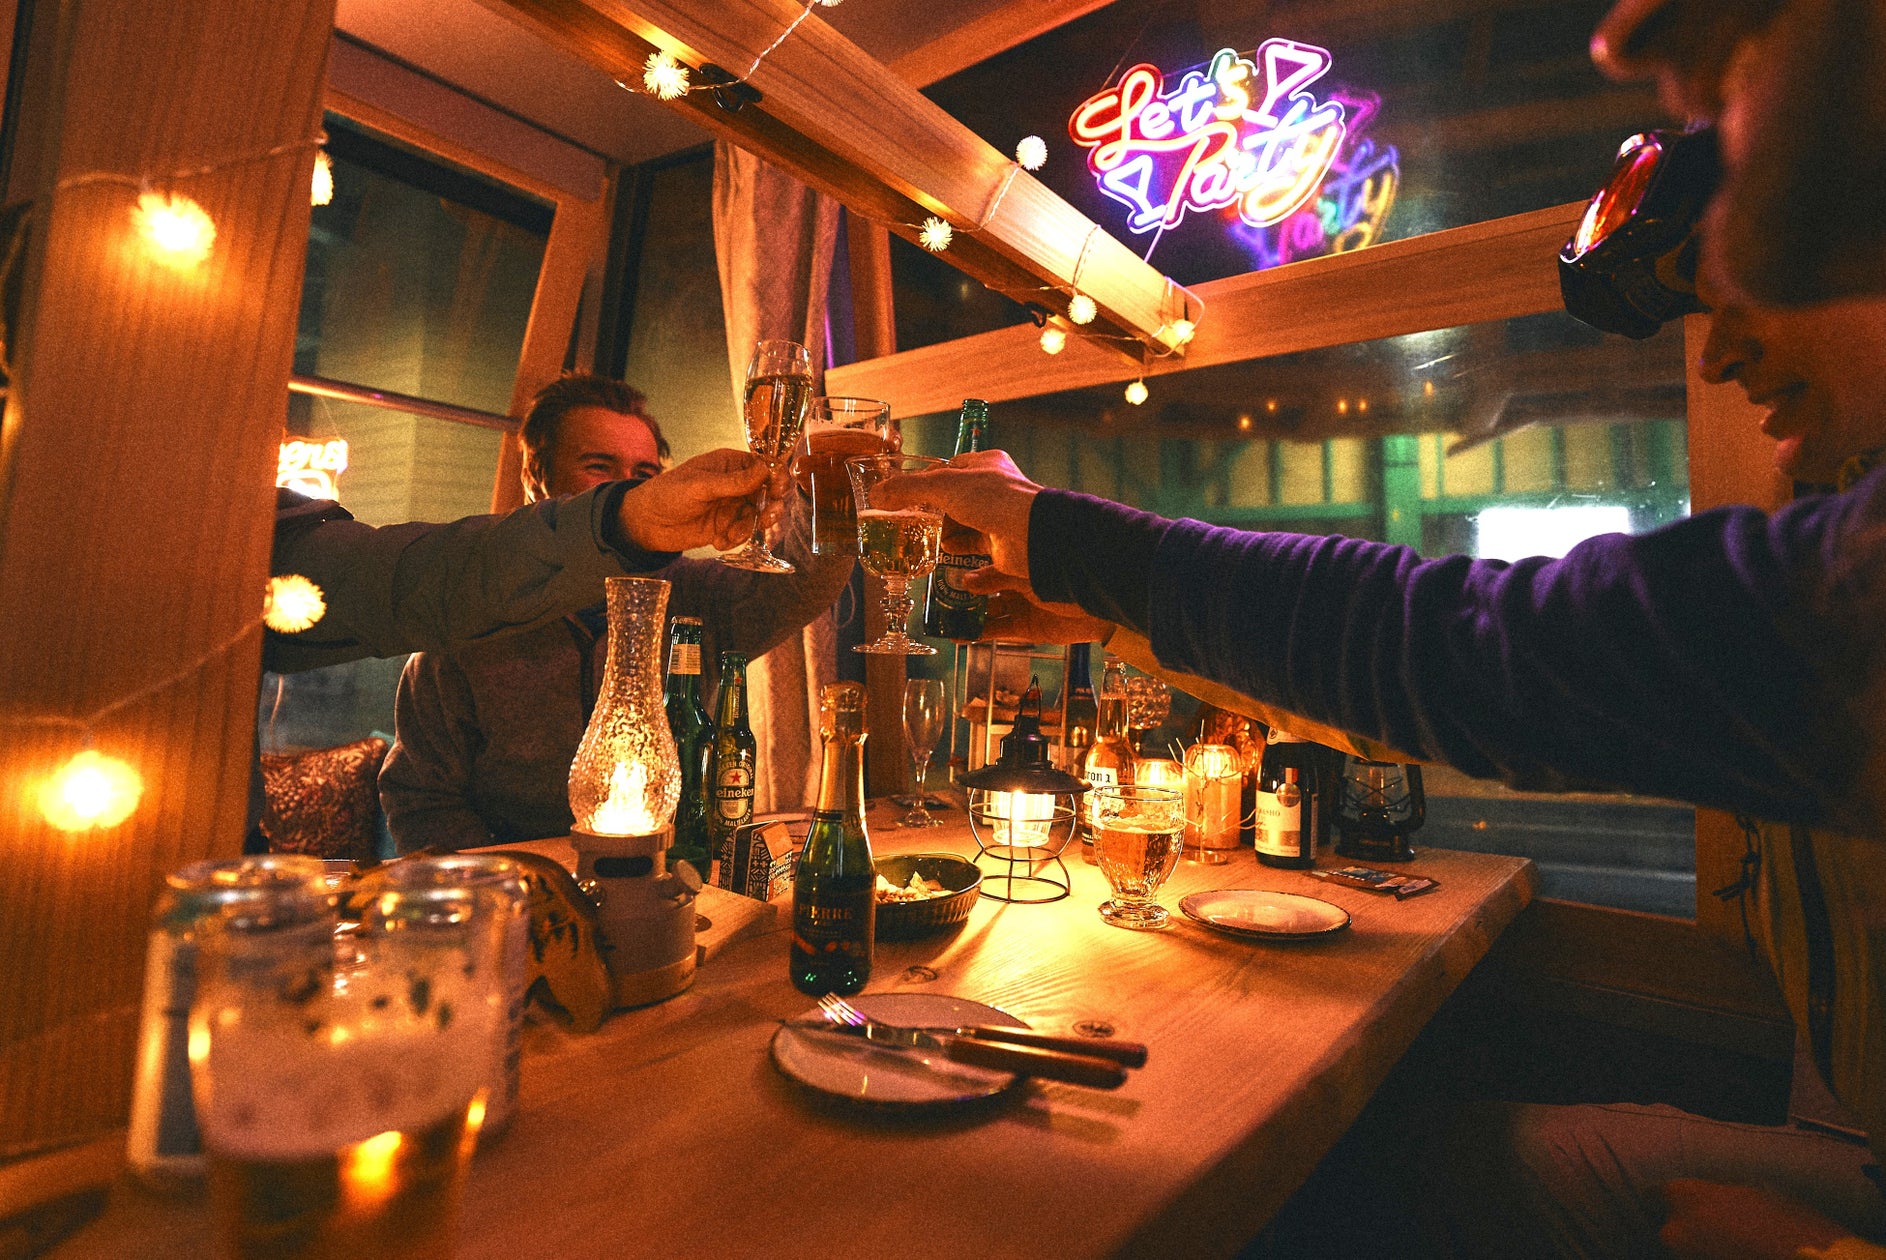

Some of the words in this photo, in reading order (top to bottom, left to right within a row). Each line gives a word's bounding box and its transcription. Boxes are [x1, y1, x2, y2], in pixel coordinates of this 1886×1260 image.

[1070, 50, 1252, 169] Let's
[1166, 99, 1340, 222] Party
[715, 787, 754, 798] eineke
